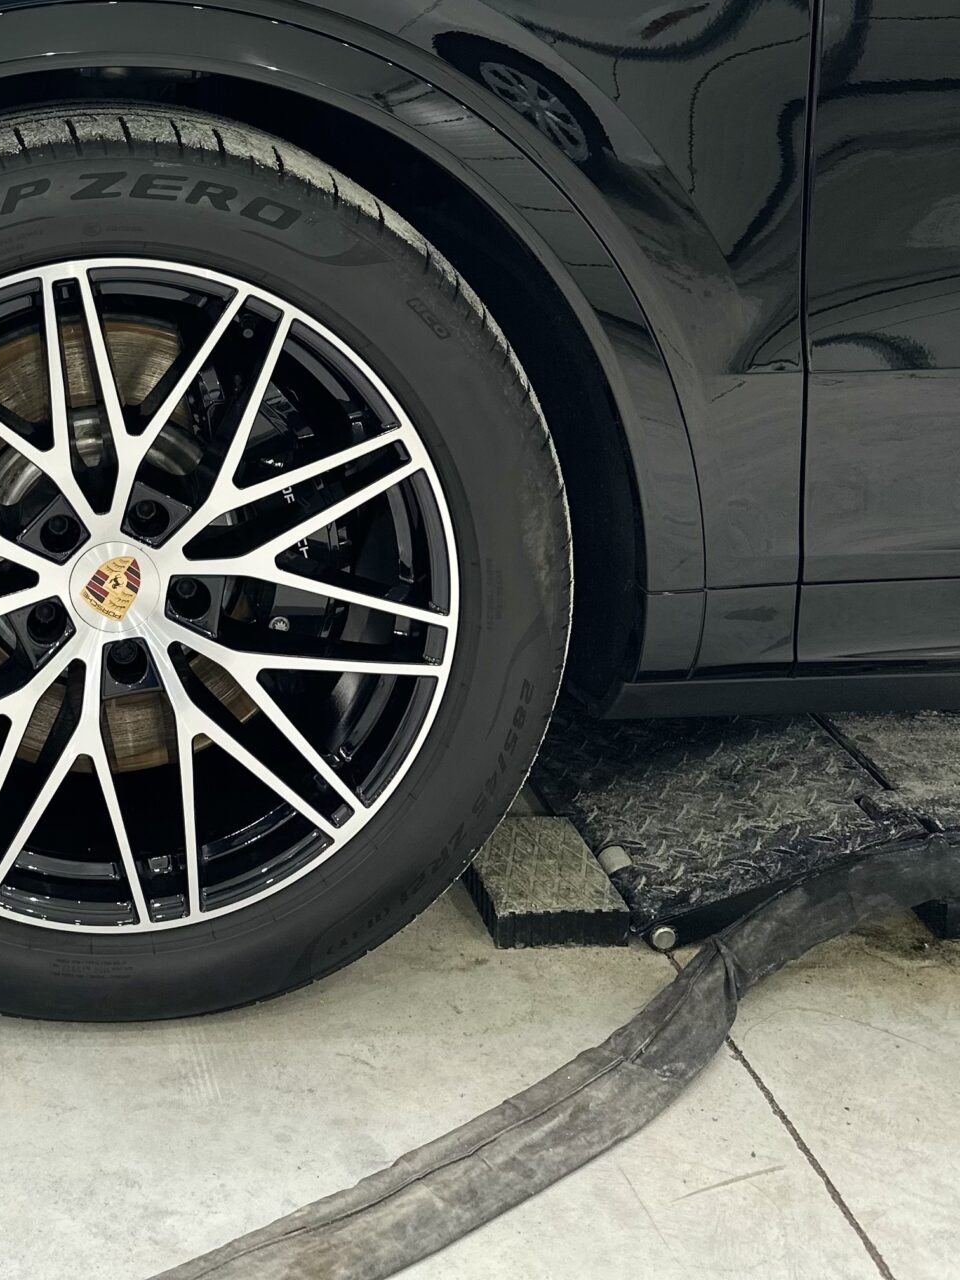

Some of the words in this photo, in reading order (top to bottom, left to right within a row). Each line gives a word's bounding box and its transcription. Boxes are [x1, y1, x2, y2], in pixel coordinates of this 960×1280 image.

[0, 177, 52, 216] P
[70, 170, 303, 231] ZERO
[81, 591, 123, 620] PORSCHE
